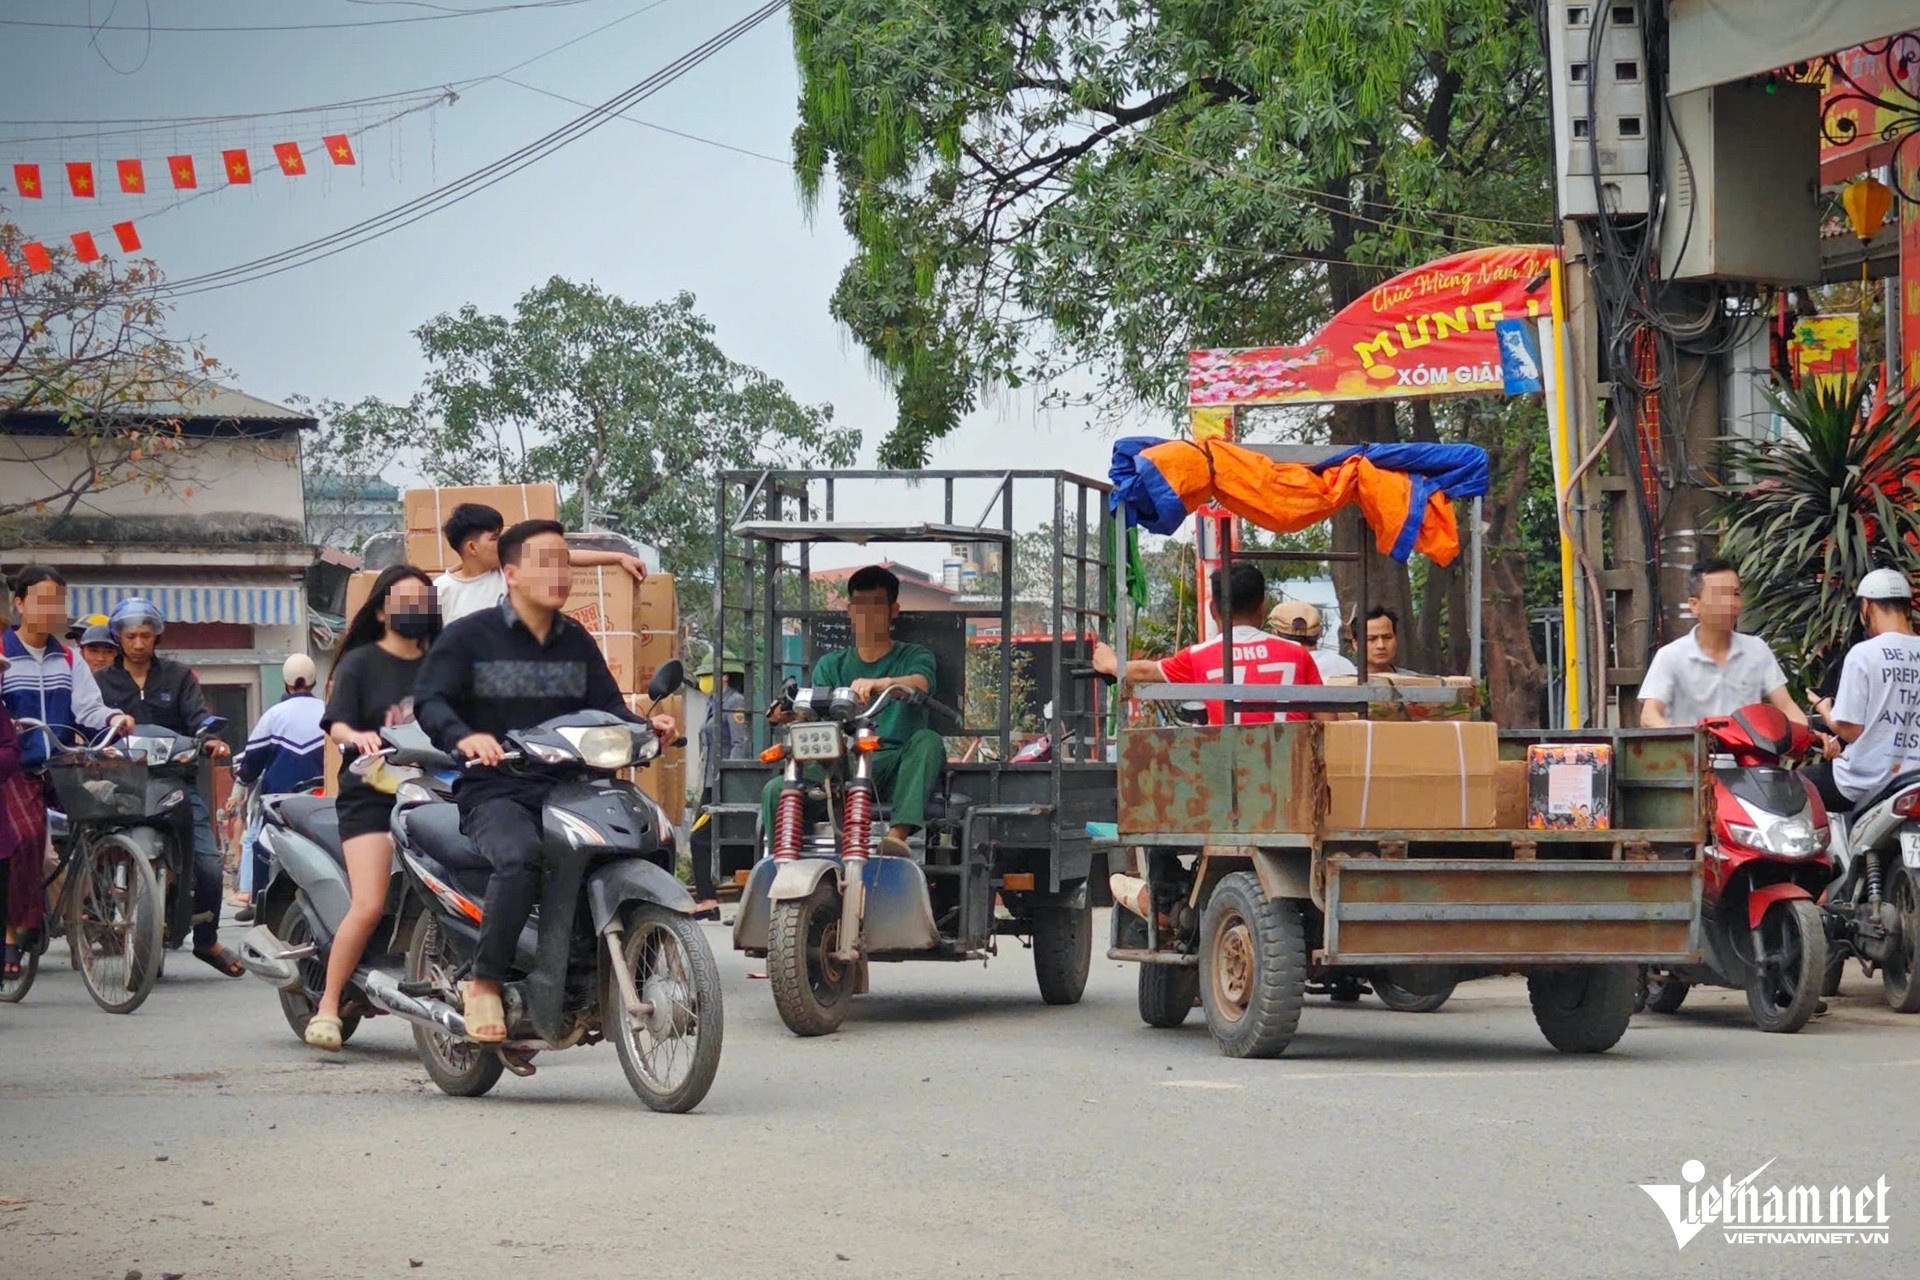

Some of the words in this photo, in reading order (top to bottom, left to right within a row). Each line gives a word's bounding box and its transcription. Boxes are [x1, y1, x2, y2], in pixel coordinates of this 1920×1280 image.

[1373, 285, 1413, 312] Chúc
[1476, 263, 1520, 284] Năm
[1397, 363, 1448, 385] XÓM
[1882, 648, 1904, 661] BE
[1882, 667, 1920, 684] PREP
[1899, 689, 1920, 705] TH
